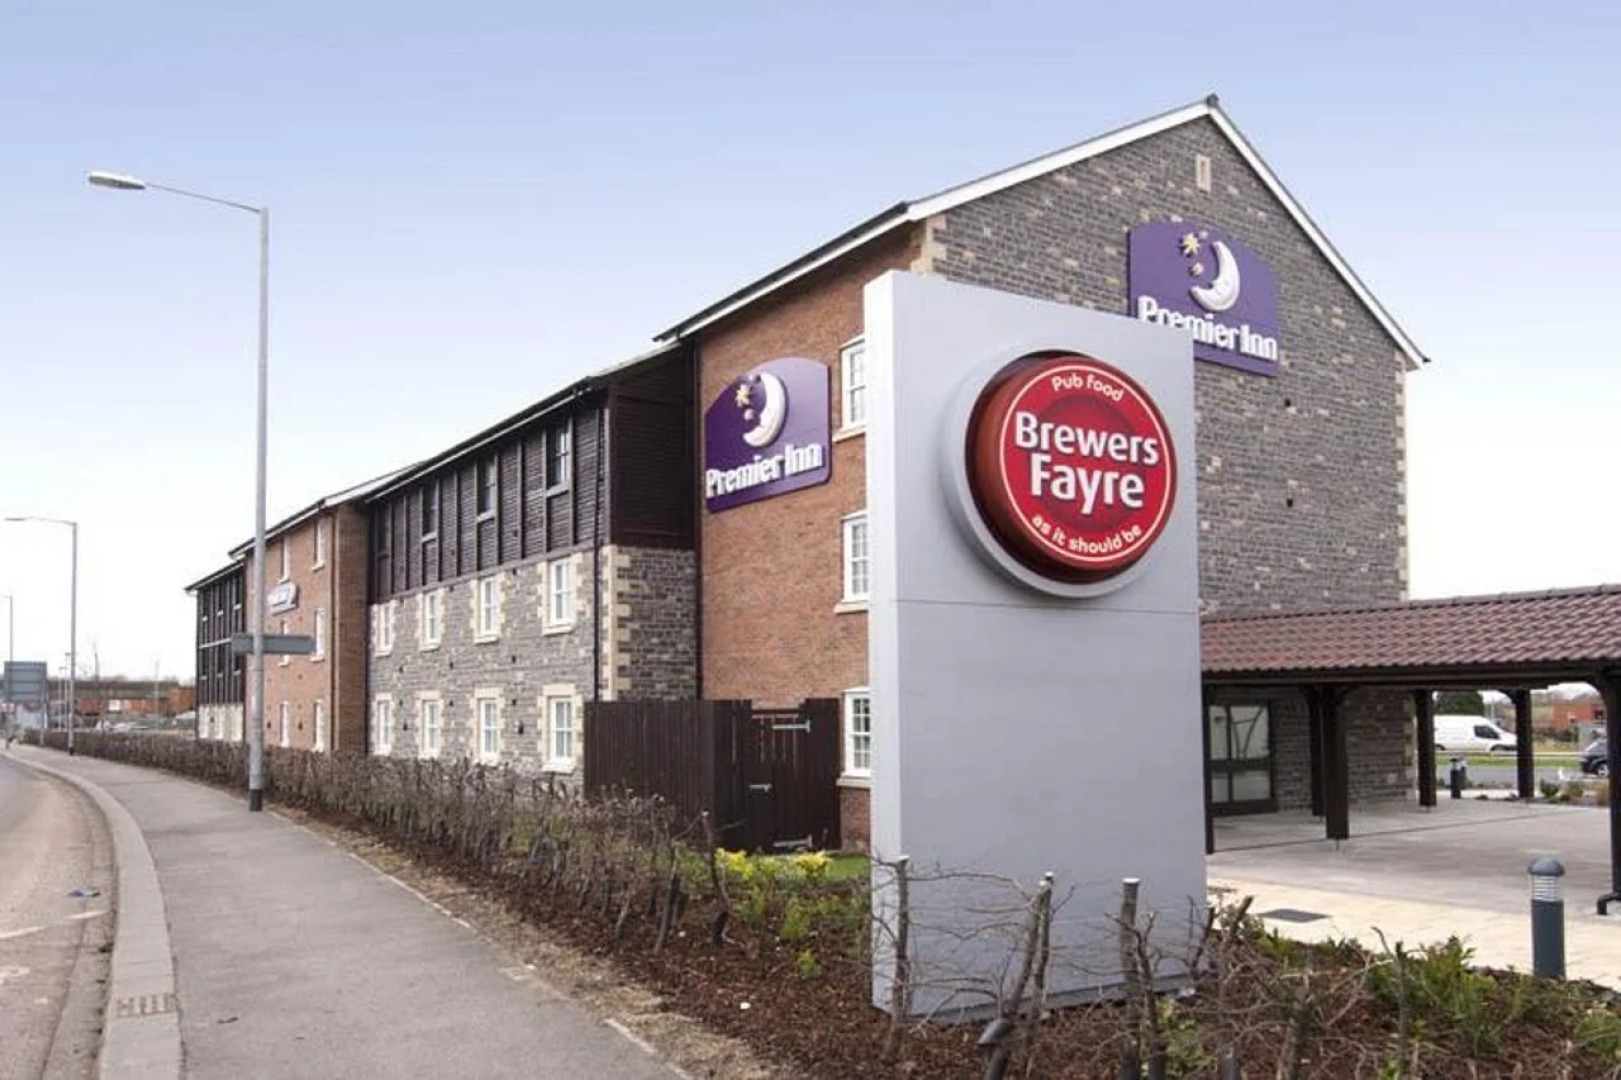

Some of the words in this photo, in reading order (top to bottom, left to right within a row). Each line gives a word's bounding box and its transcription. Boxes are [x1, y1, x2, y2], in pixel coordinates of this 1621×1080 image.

[1240, 324, 1278, 360] Inn
[1052, 374, 1083, 391] Pub
[1015, 411, 1159, 465] Brewers
[705, 455, 783, 497] Premier
[785, 443, 823, 476] Inn
[1030, 453, 1144, 515] Fayre
[1032, 514, 1050, 534] as
[1052, 526, 1066, 545] it
[1068, 535, 1122, 554] should
[1123, 523, 1142, 542] be
